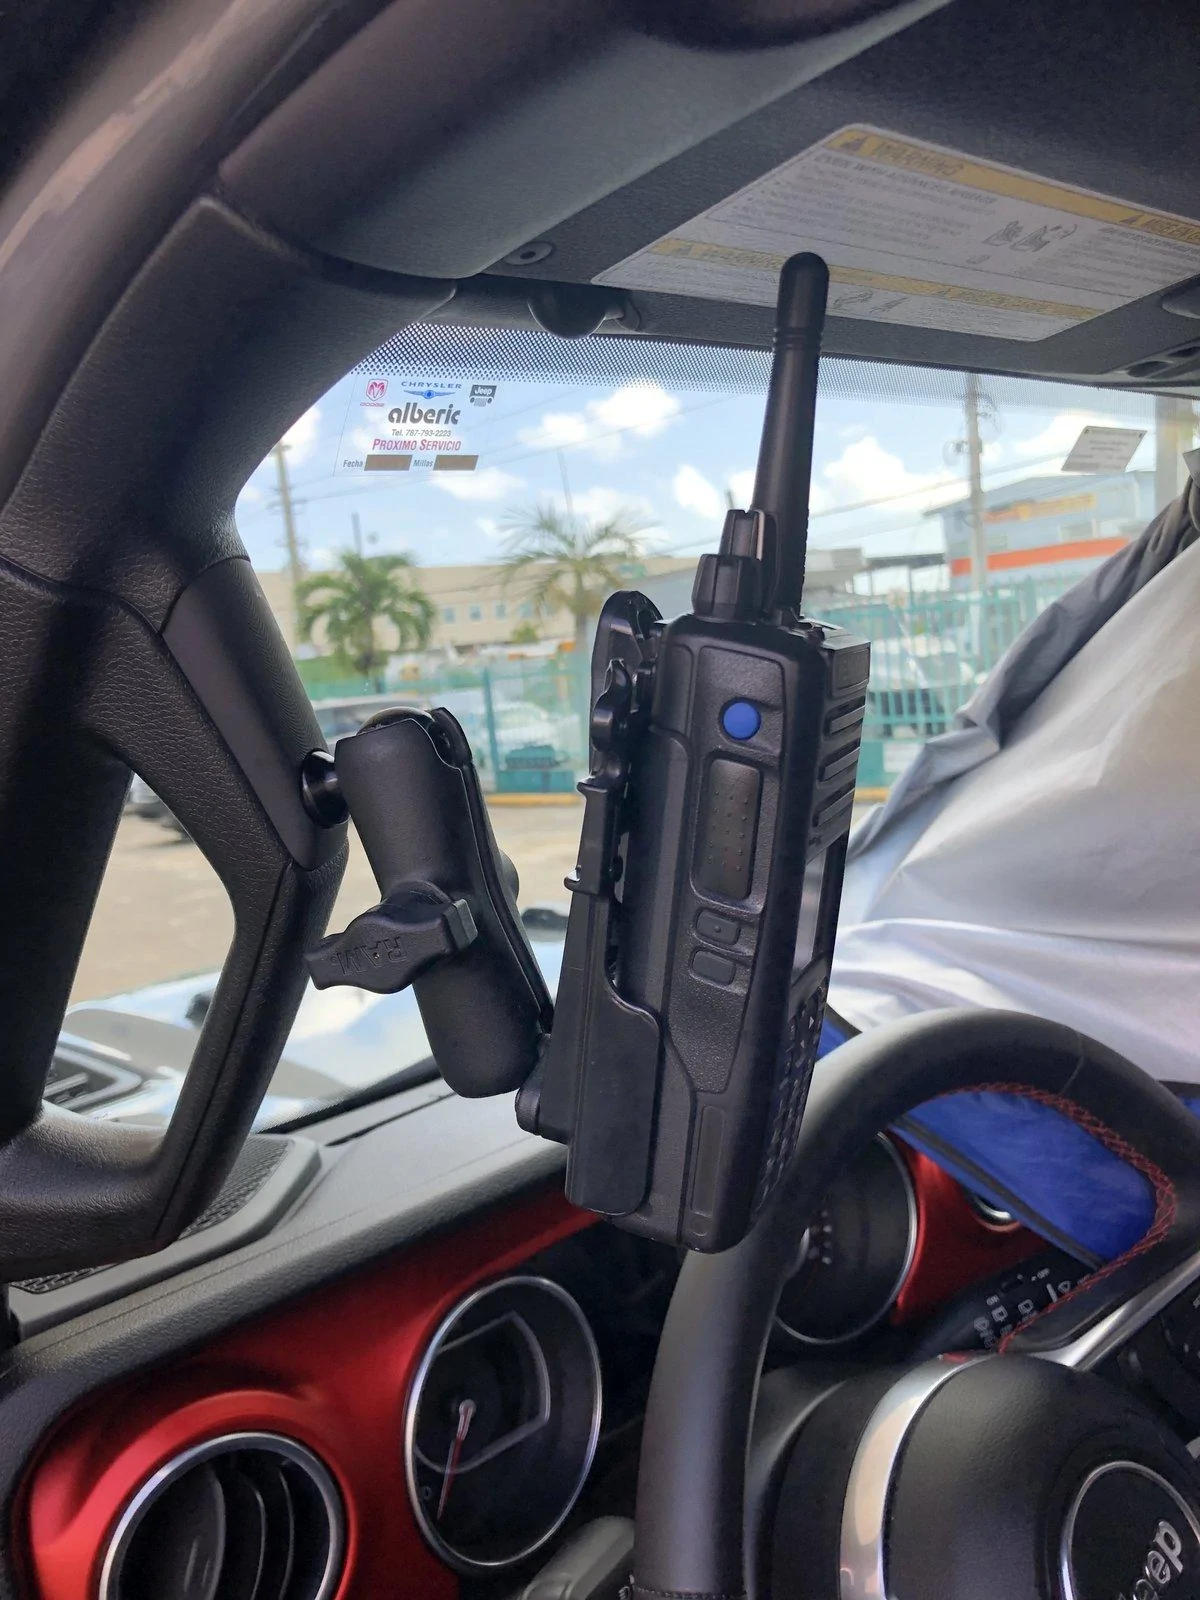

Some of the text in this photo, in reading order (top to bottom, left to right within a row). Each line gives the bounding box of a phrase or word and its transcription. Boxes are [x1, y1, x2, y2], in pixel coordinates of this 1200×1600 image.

[401, 381, 462, 389] CHRYSLER
[474, 386, 493, 396] Jeep
[389, 402, 461, 424] alberic
[405, 429, 452, 437] 787-793-2223
[372, 438, 462, 451] PROXIMO SERVICIO
[343, 459, 434, 468] Fecha Millas
